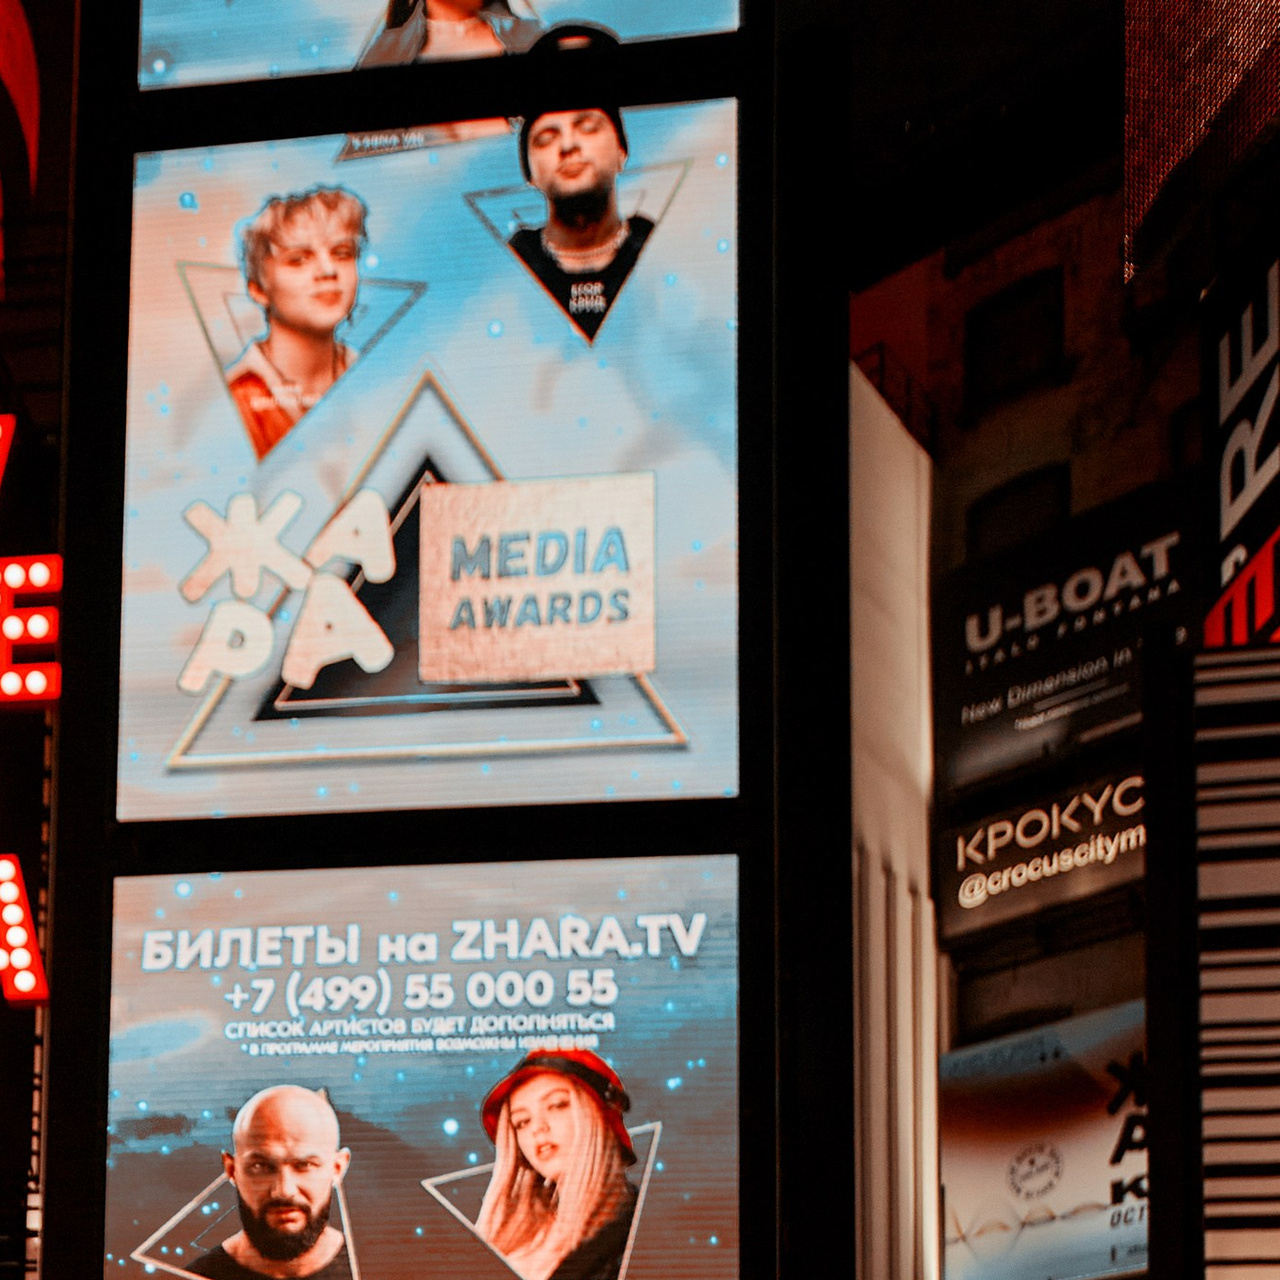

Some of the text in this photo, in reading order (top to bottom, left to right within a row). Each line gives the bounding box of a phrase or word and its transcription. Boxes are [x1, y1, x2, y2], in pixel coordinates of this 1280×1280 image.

[451, 525, 630, 581] MEDIA
[449, 588, 629, 630] AWARDS
[965, 530, 1181, 652] U-BOAT
[1007, 656, 1109, 709] Dimension
[957, 775, 1145, 872] КРОКУС
[141, 912, 707, 972] БИЛЕТЫ на ZHARA.TV
[224, 967, 619, 1017] +7 (499) 55 000 55
[224, 1012, 616, 1039] СПИСОК АРТИСТОВ БУДЕТ ДОПОЛНЯТЬСЯ
